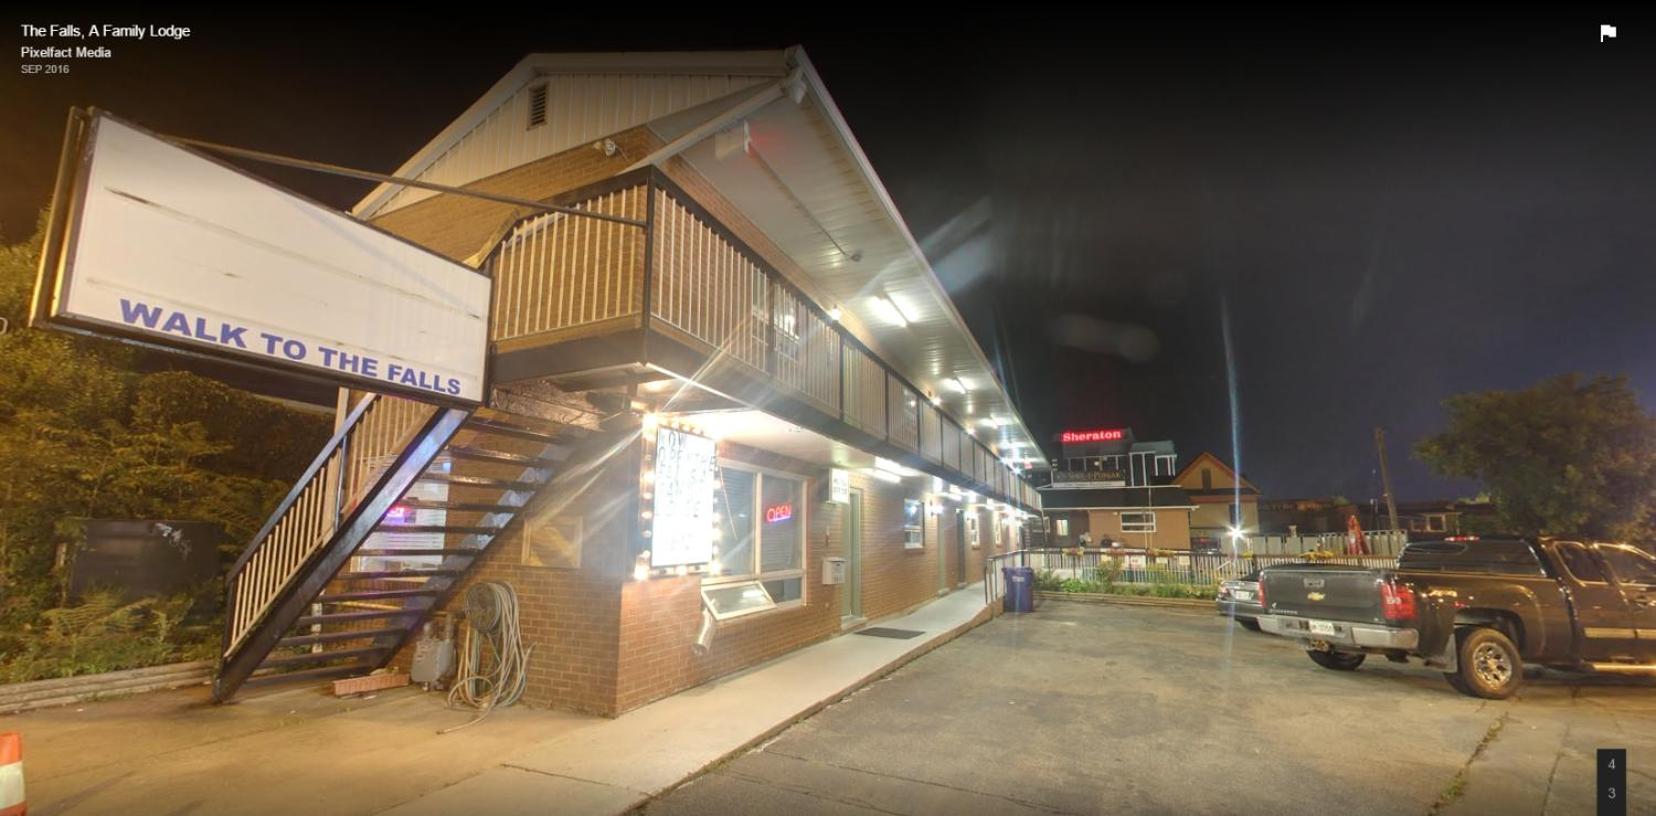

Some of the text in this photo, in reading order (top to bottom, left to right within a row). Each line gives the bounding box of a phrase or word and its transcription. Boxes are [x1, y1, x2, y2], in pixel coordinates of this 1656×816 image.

[120, 298, 462, 396] WALK TO THE FALLS
[1062, 430, 1121, 442] Sheraton
[766, 504, 792, 522] OPEN
